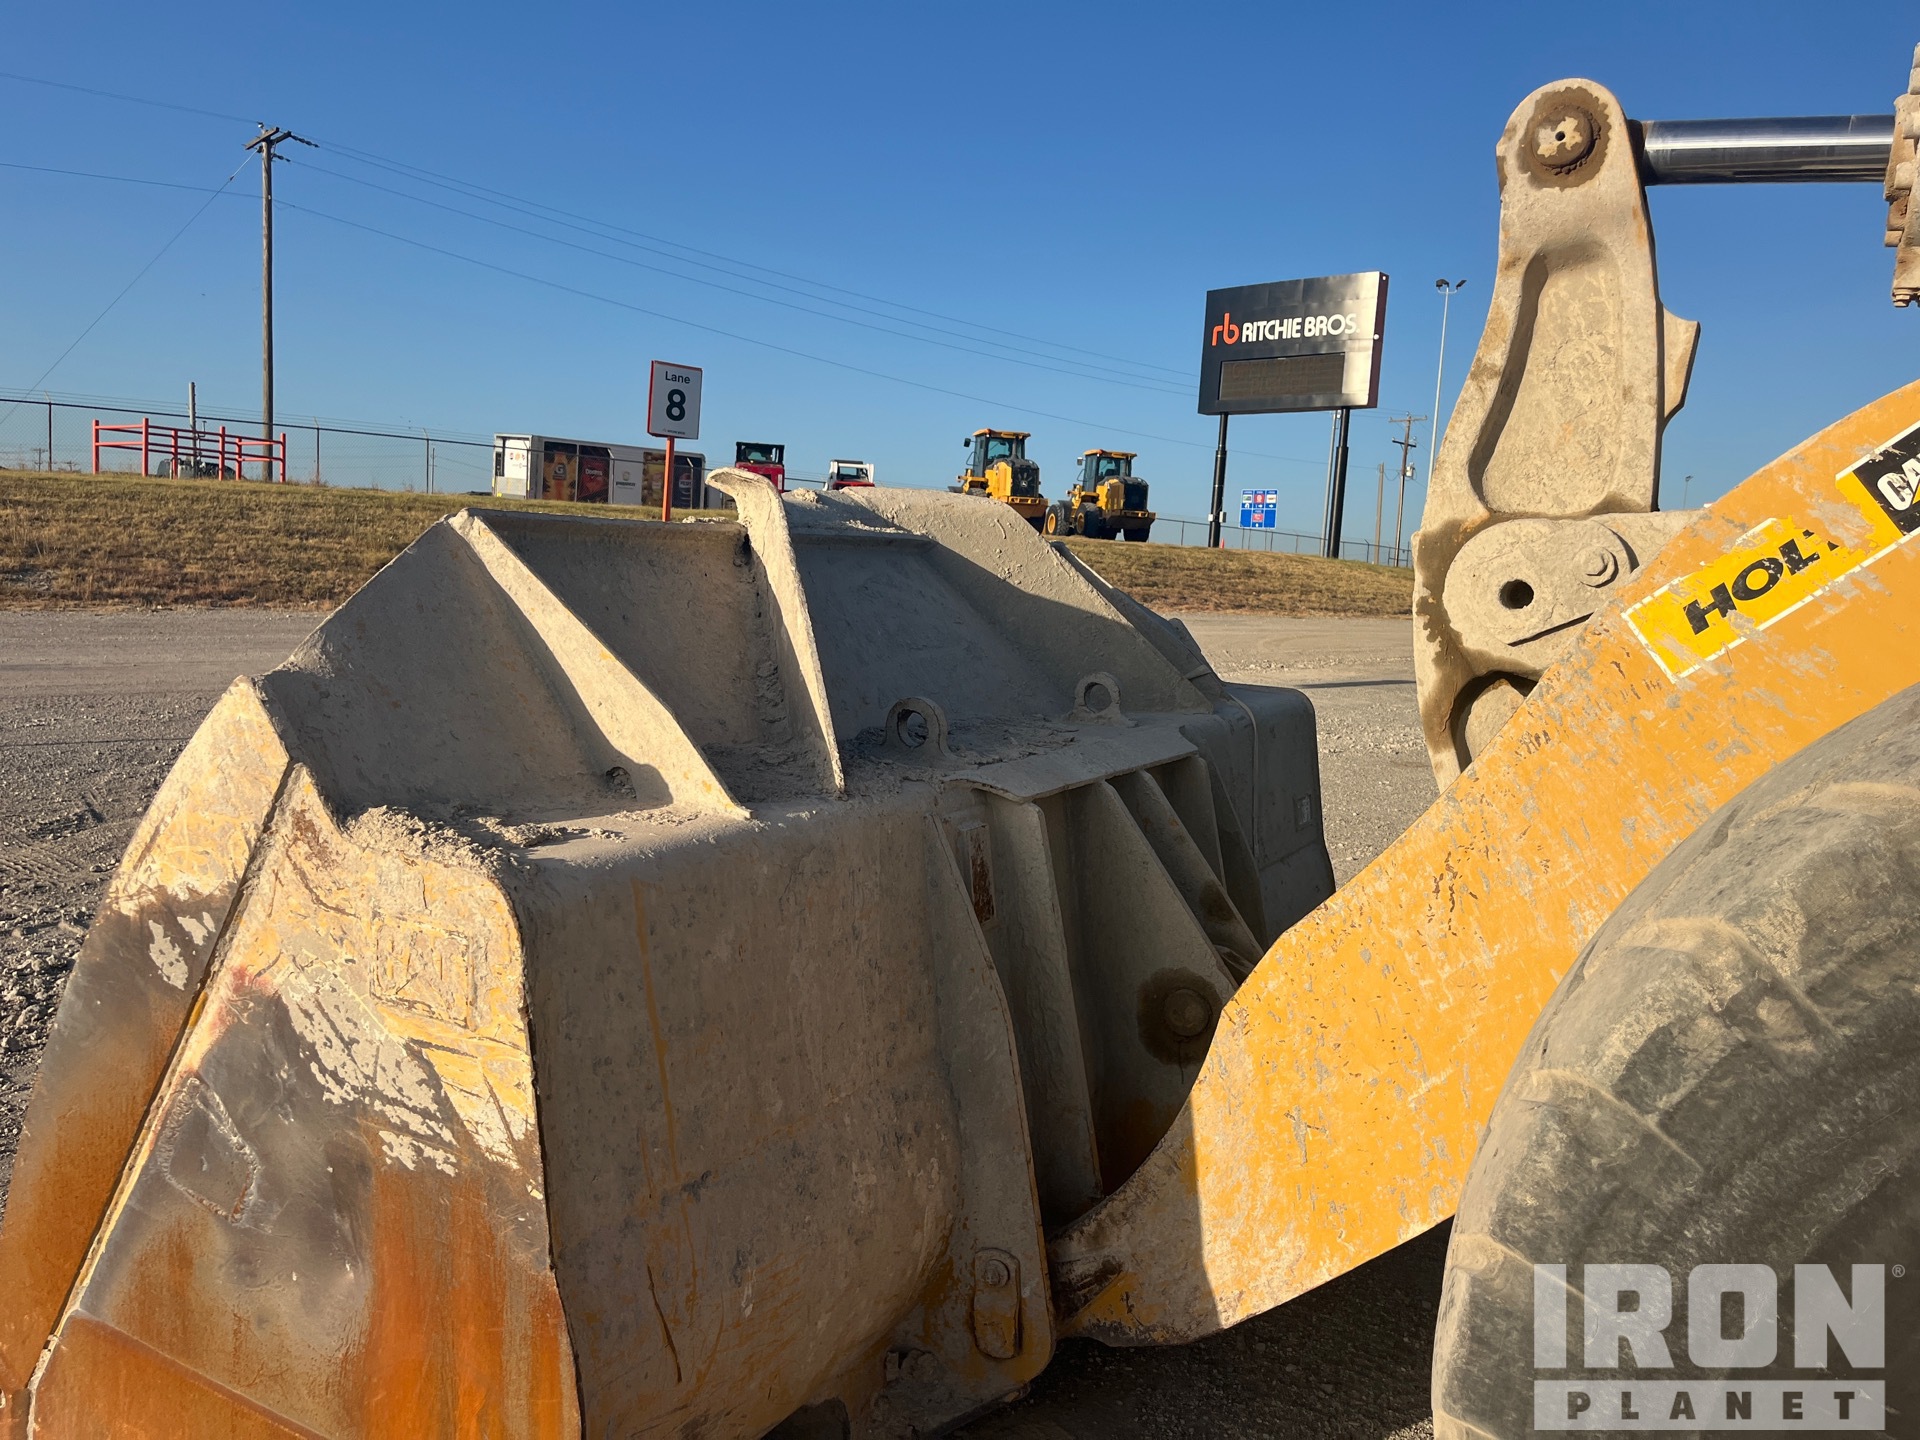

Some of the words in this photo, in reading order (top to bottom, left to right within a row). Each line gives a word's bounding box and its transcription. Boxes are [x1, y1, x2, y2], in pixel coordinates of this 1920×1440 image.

[1241, 317, 1302, 343] RITCHIE
[665, 371, 691, 384] Lane
[666, 389, 686, 421] 8
